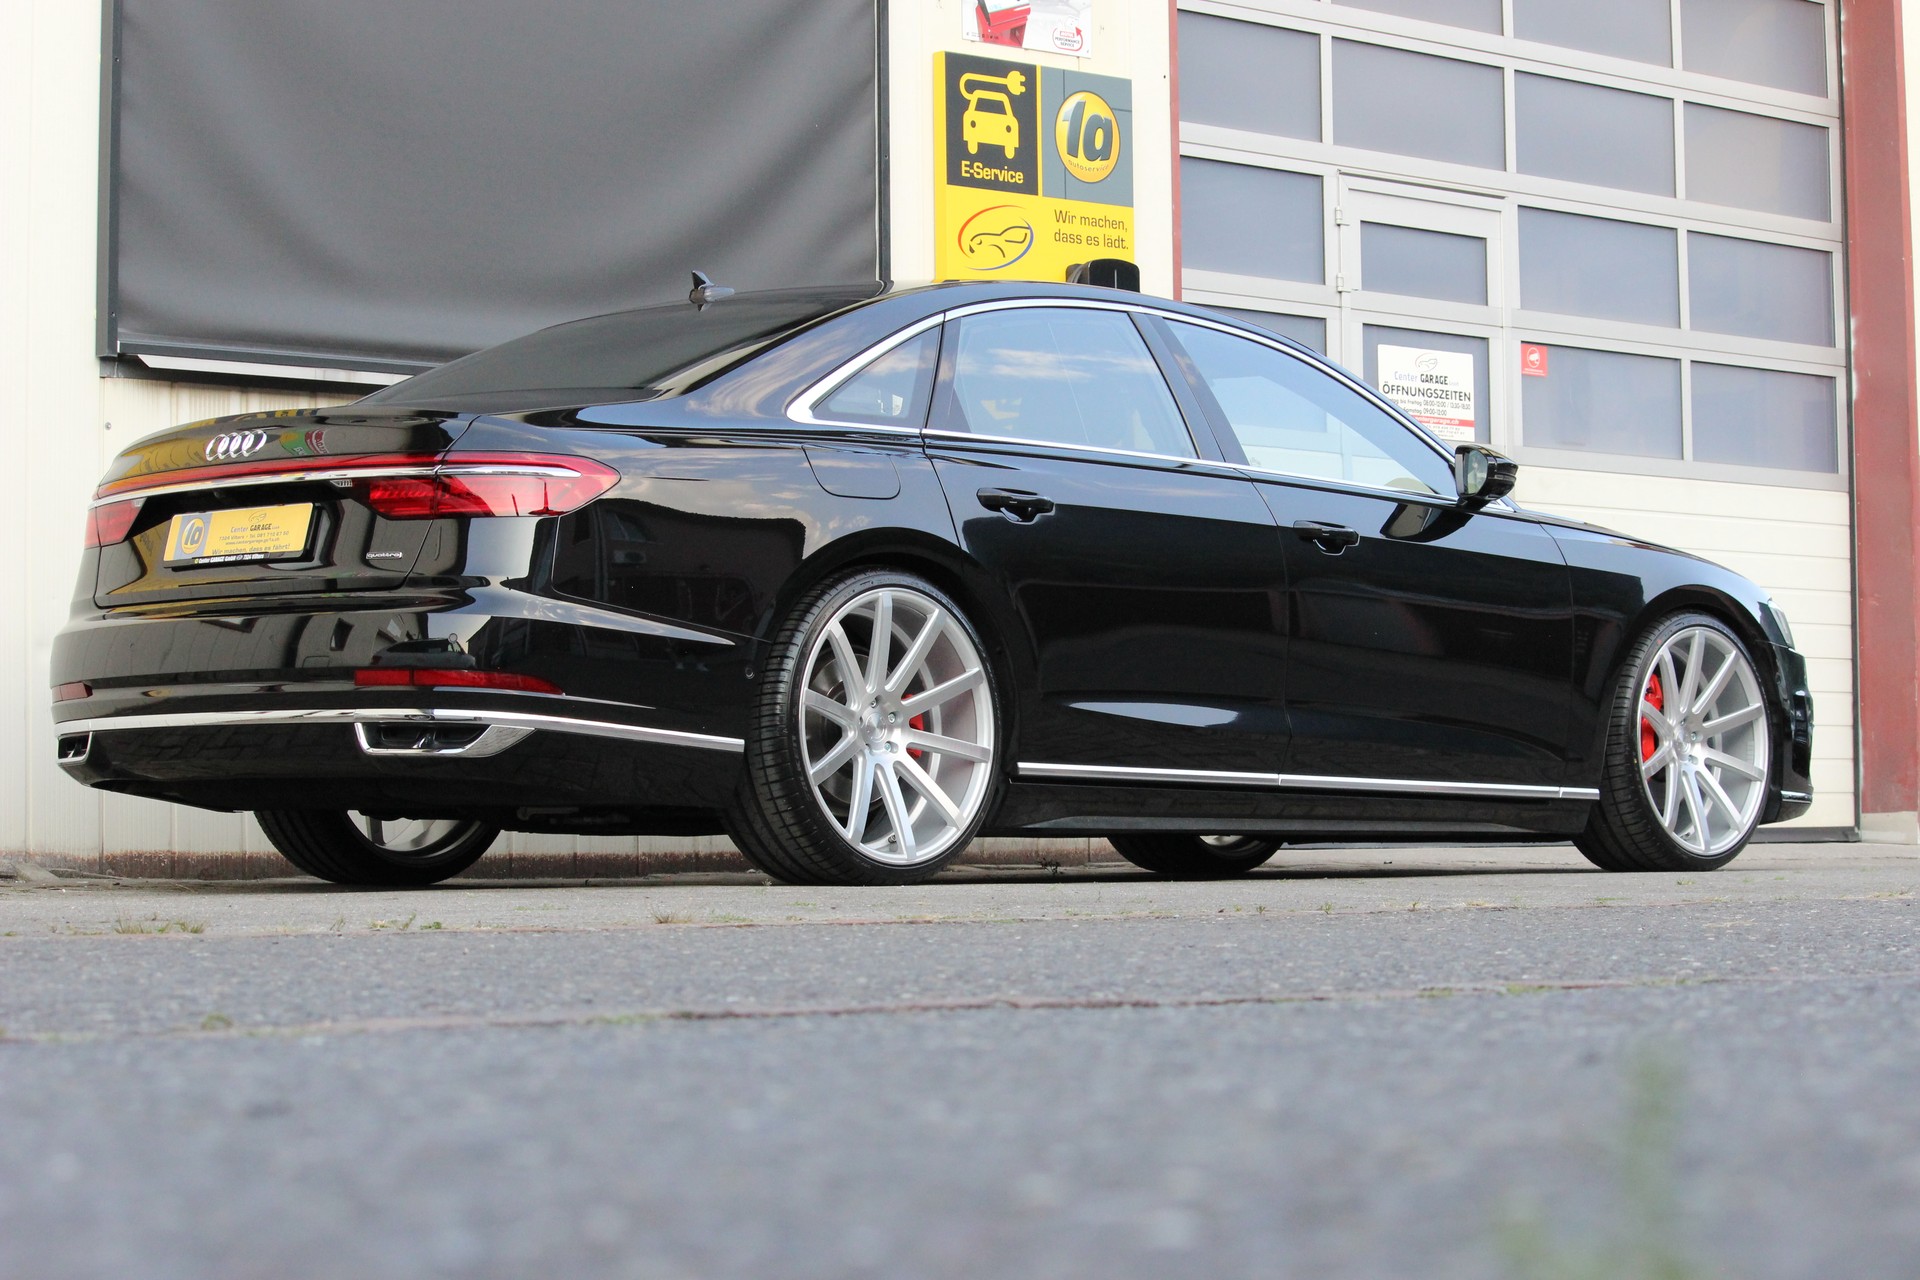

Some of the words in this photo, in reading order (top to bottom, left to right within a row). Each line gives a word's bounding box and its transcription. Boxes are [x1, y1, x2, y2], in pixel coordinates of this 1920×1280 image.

[961, 160, 1024, 184] E-Service
[1054, 208, 1077, 225] Wir
[1080, 213, 1128, 233] machen,
[1054, 228, 1083, 246] dass
[1086, 233, 1100, 247] es
[1103, 233, 1129, 251] lädt.
[1394, 371, 1418, 383] Center
[1420, 373, 1449, 386] GARAGE
[1382, 380, 1472, 403] ÖFFNUNGSZEITEN
[230, 526, 249, 534] Center
[249, 523, 272, 532] GARAGE
